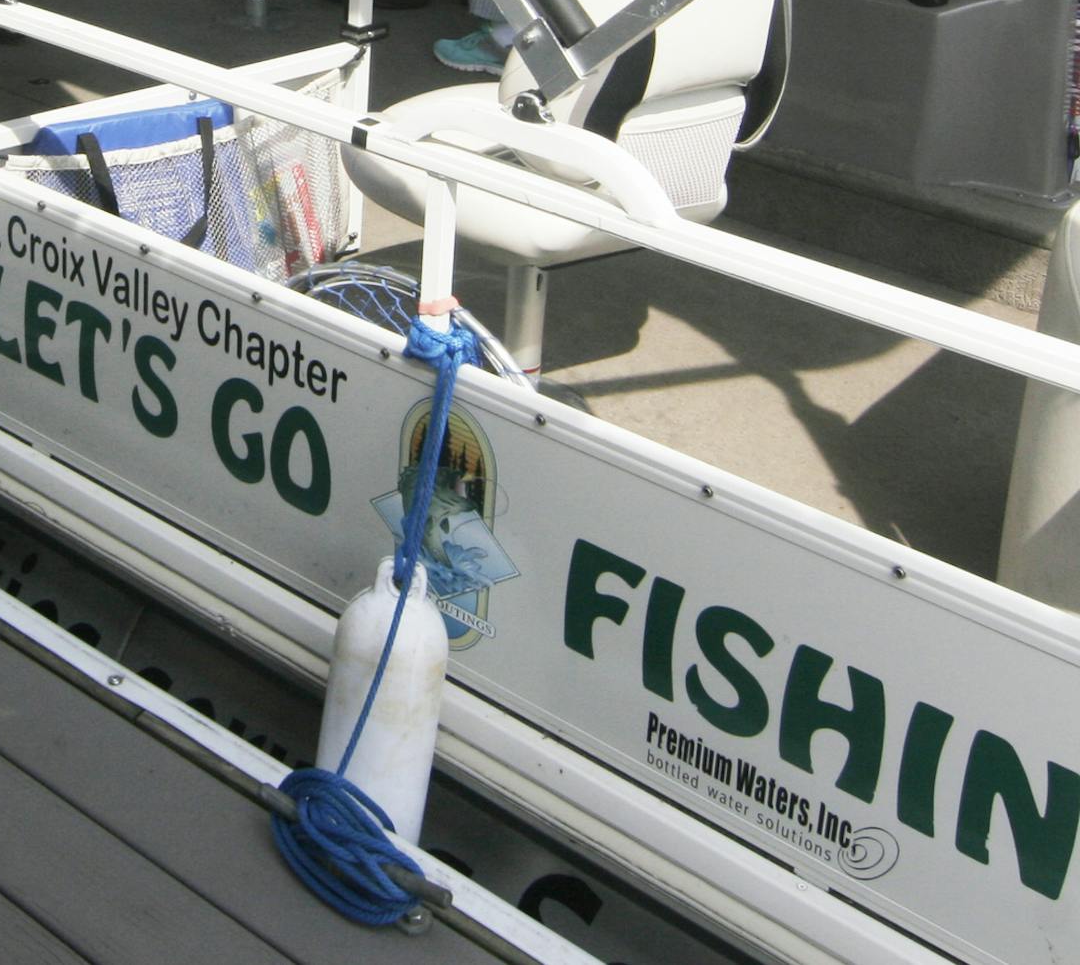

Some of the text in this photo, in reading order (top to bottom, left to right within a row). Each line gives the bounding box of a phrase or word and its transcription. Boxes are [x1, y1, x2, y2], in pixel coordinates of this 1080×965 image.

[8, 215, 86, 287] Croix
[92, 249, 189, 342] Valley
[197, 299, 348, 403] Chapter
[211, 377, 332, 517] GO
[563, 538, 1080, 901] FISHIN
[646, 711, 733, 786] Premium
[735, 758, 813, 833] Waters,
[646, 750, 833, 862] bottled water solutions
